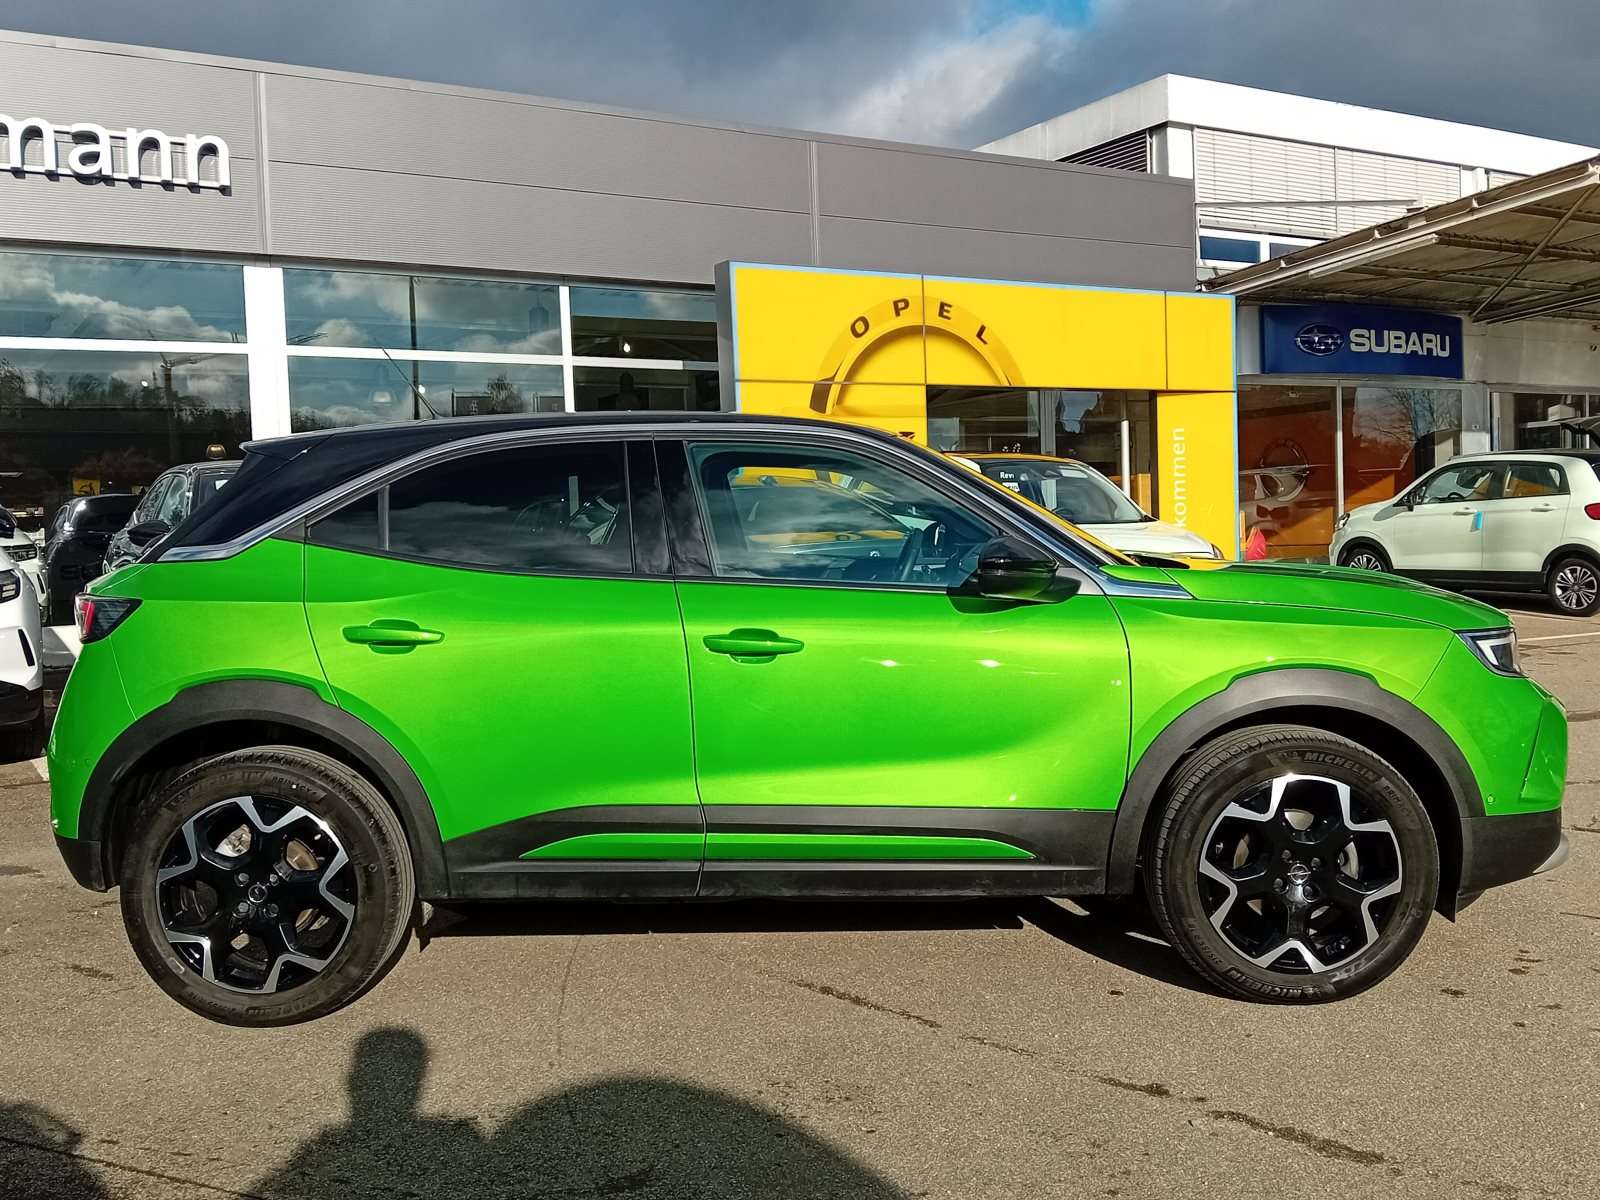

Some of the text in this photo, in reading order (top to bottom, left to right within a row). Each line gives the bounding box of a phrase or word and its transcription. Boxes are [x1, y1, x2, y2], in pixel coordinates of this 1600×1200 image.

[850, 298, 988, 345] OPEL
[1350, 328, 1450, 357] SUBARU
[1303, 752, 1379, 781] MICHELIN
